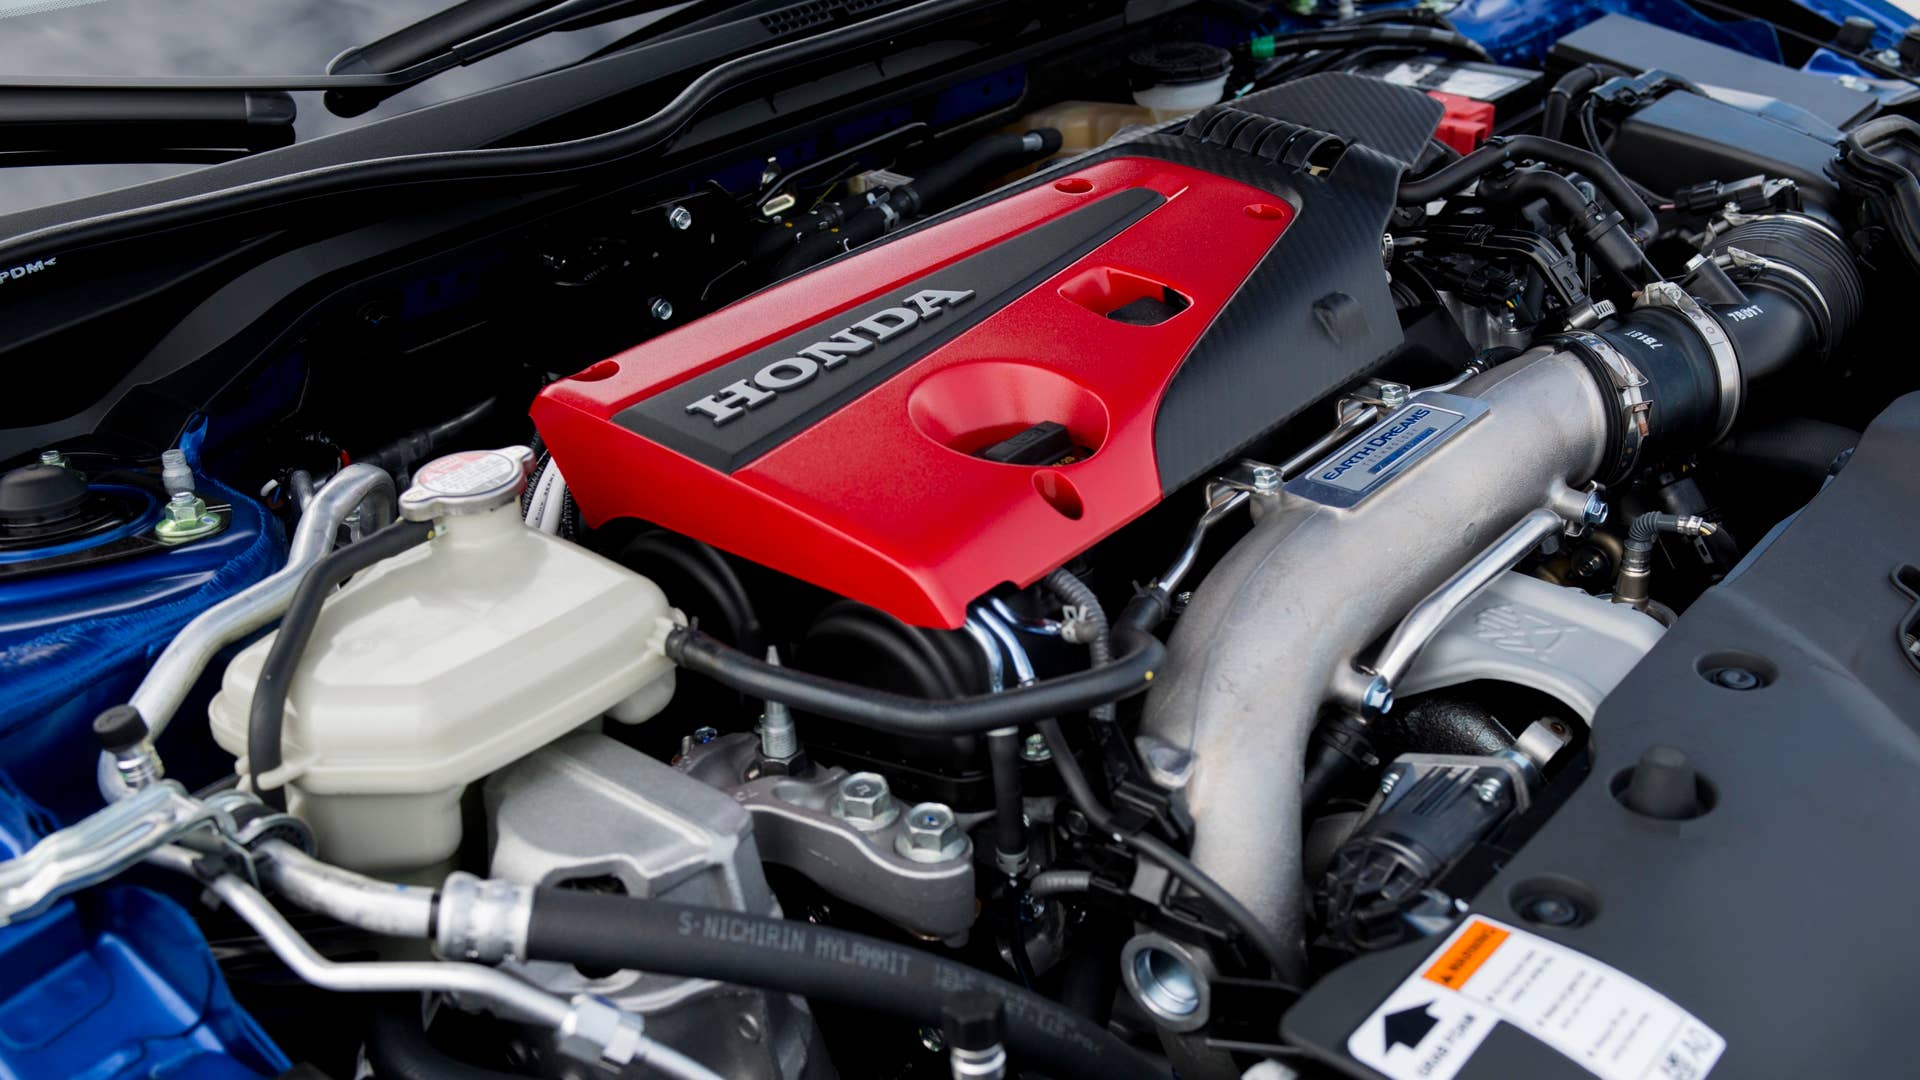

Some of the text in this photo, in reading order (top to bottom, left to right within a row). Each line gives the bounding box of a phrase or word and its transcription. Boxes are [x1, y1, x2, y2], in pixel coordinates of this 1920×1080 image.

[685, 289, 976, 427] HONDA
[1322, 446, 1376, 481] EARTH
[1367, 408, 1431, 447] DREAMS
